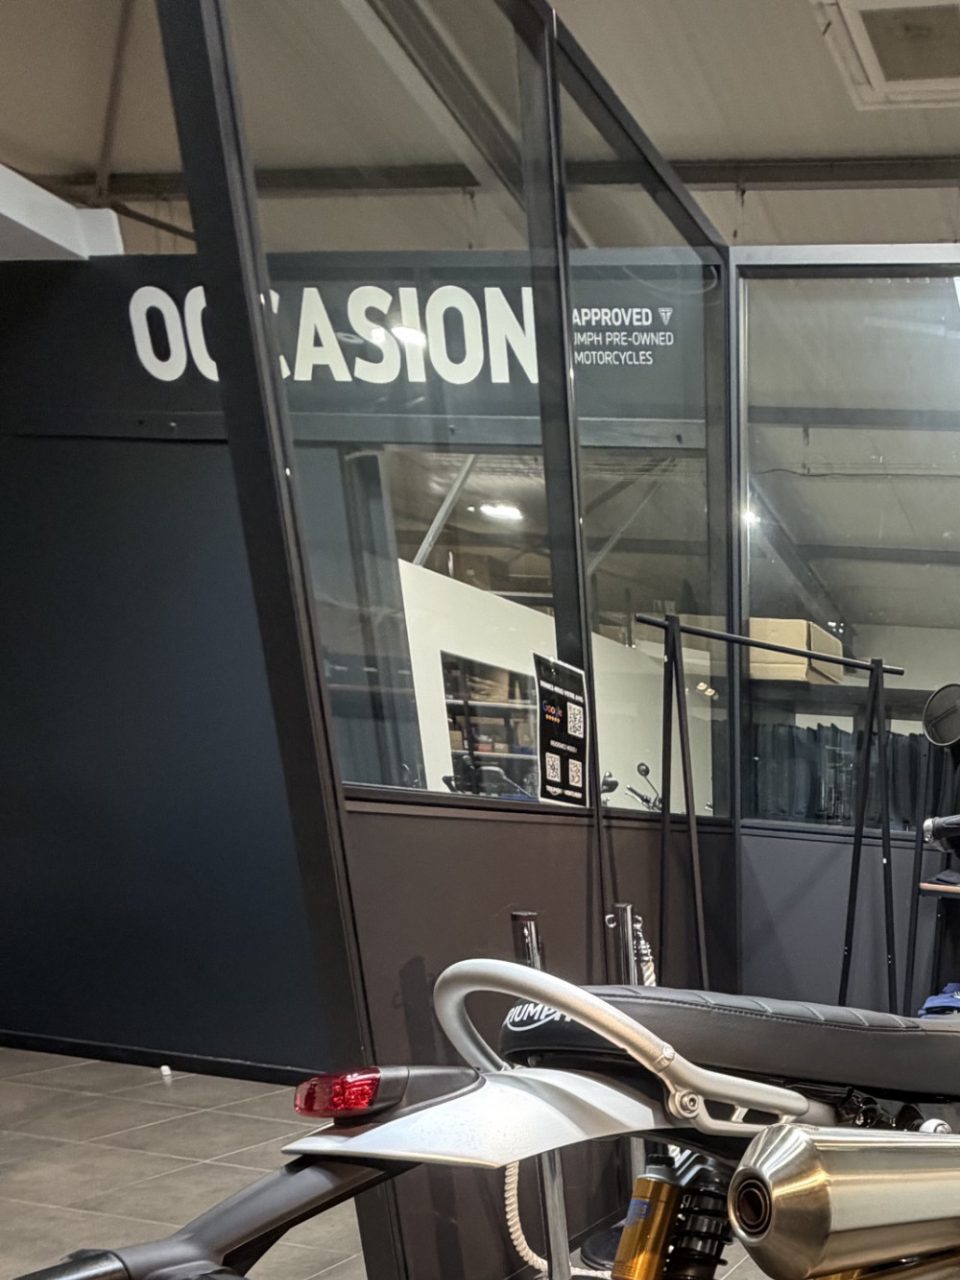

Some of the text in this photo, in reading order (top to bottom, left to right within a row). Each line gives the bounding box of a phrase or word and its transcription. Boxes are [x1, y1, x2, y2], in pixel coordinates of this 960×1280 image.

[572, 307, 653, 326] APPROVED
[129, 285, 539, 384] OCASION
[605, 331, 674, 345] PRE-OWNED
[574, 351, 653, 365] MOTORCYCLES
